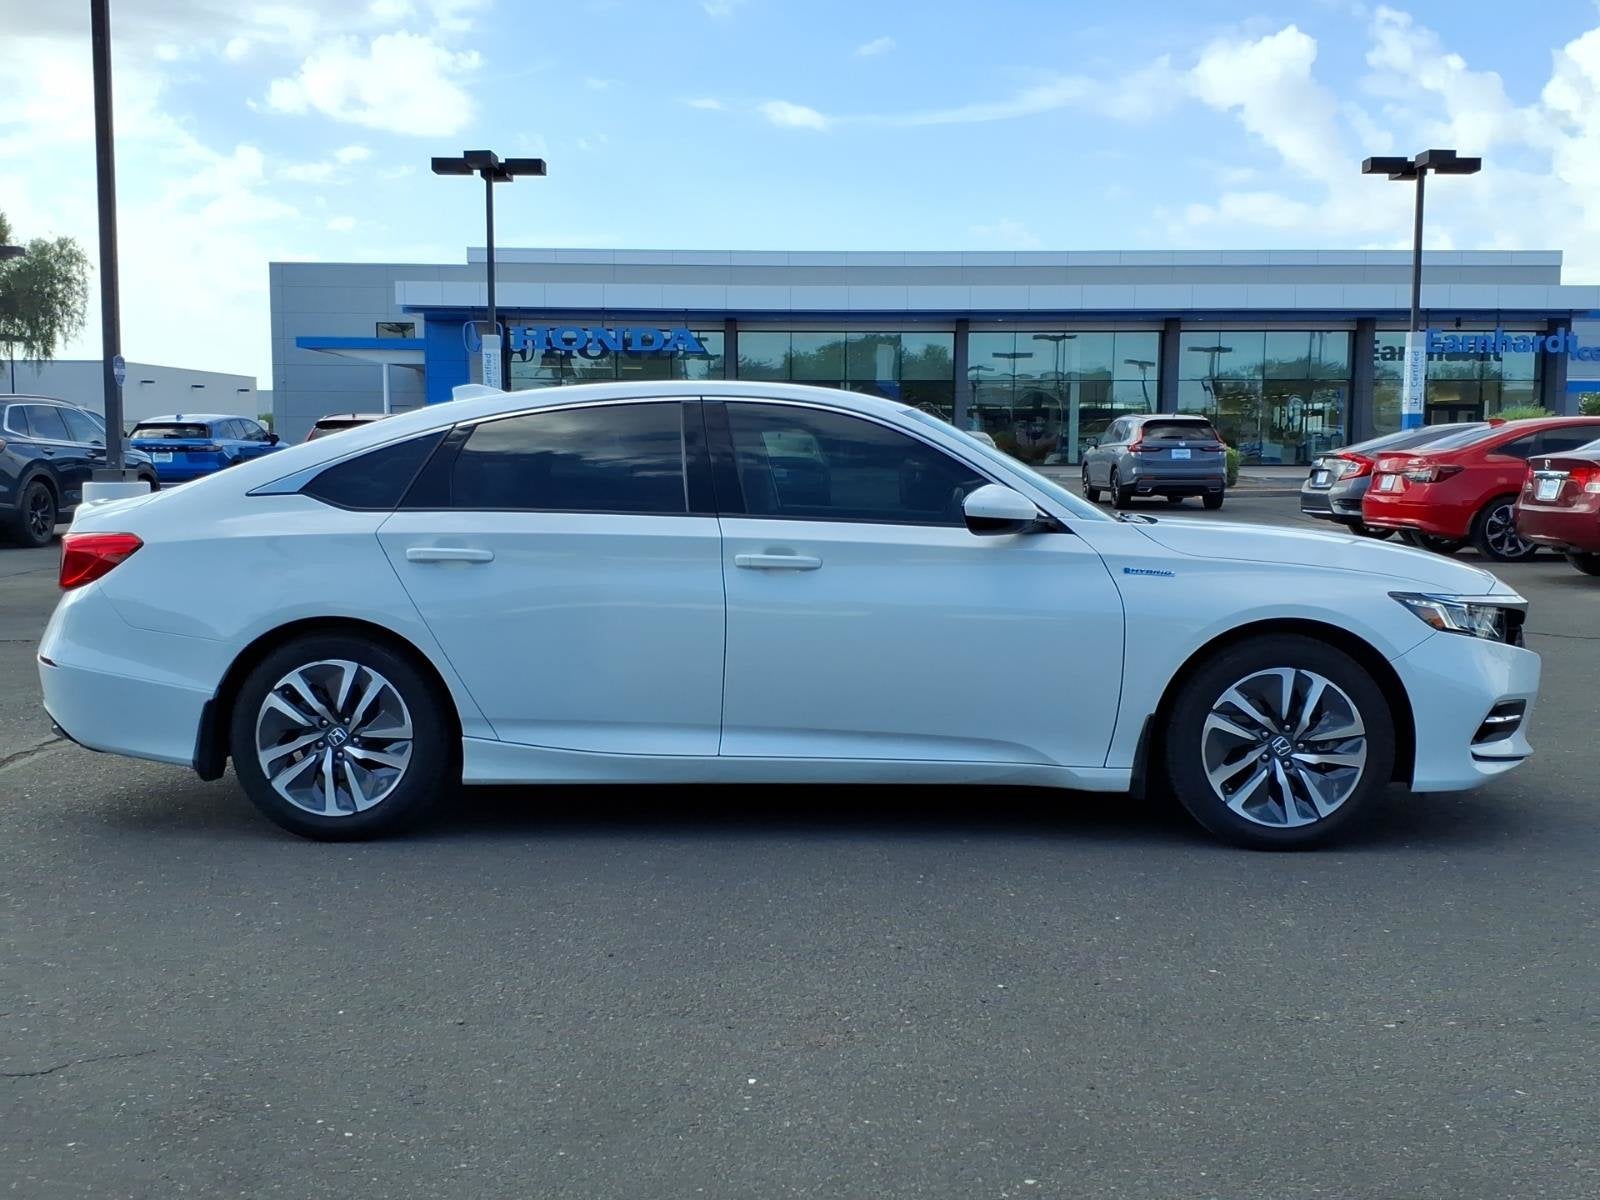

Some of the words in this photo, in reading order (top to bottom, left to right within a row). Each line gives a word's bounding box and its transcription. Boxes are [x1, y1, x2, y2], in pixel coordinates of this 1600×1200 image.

[509, 327, 705, 352] HONDA
[1425, 327, 1578, 353] Earnhardt
[484, 353, 492, 387] ertified
[1131, 568, 1176, 577] HYBRID
